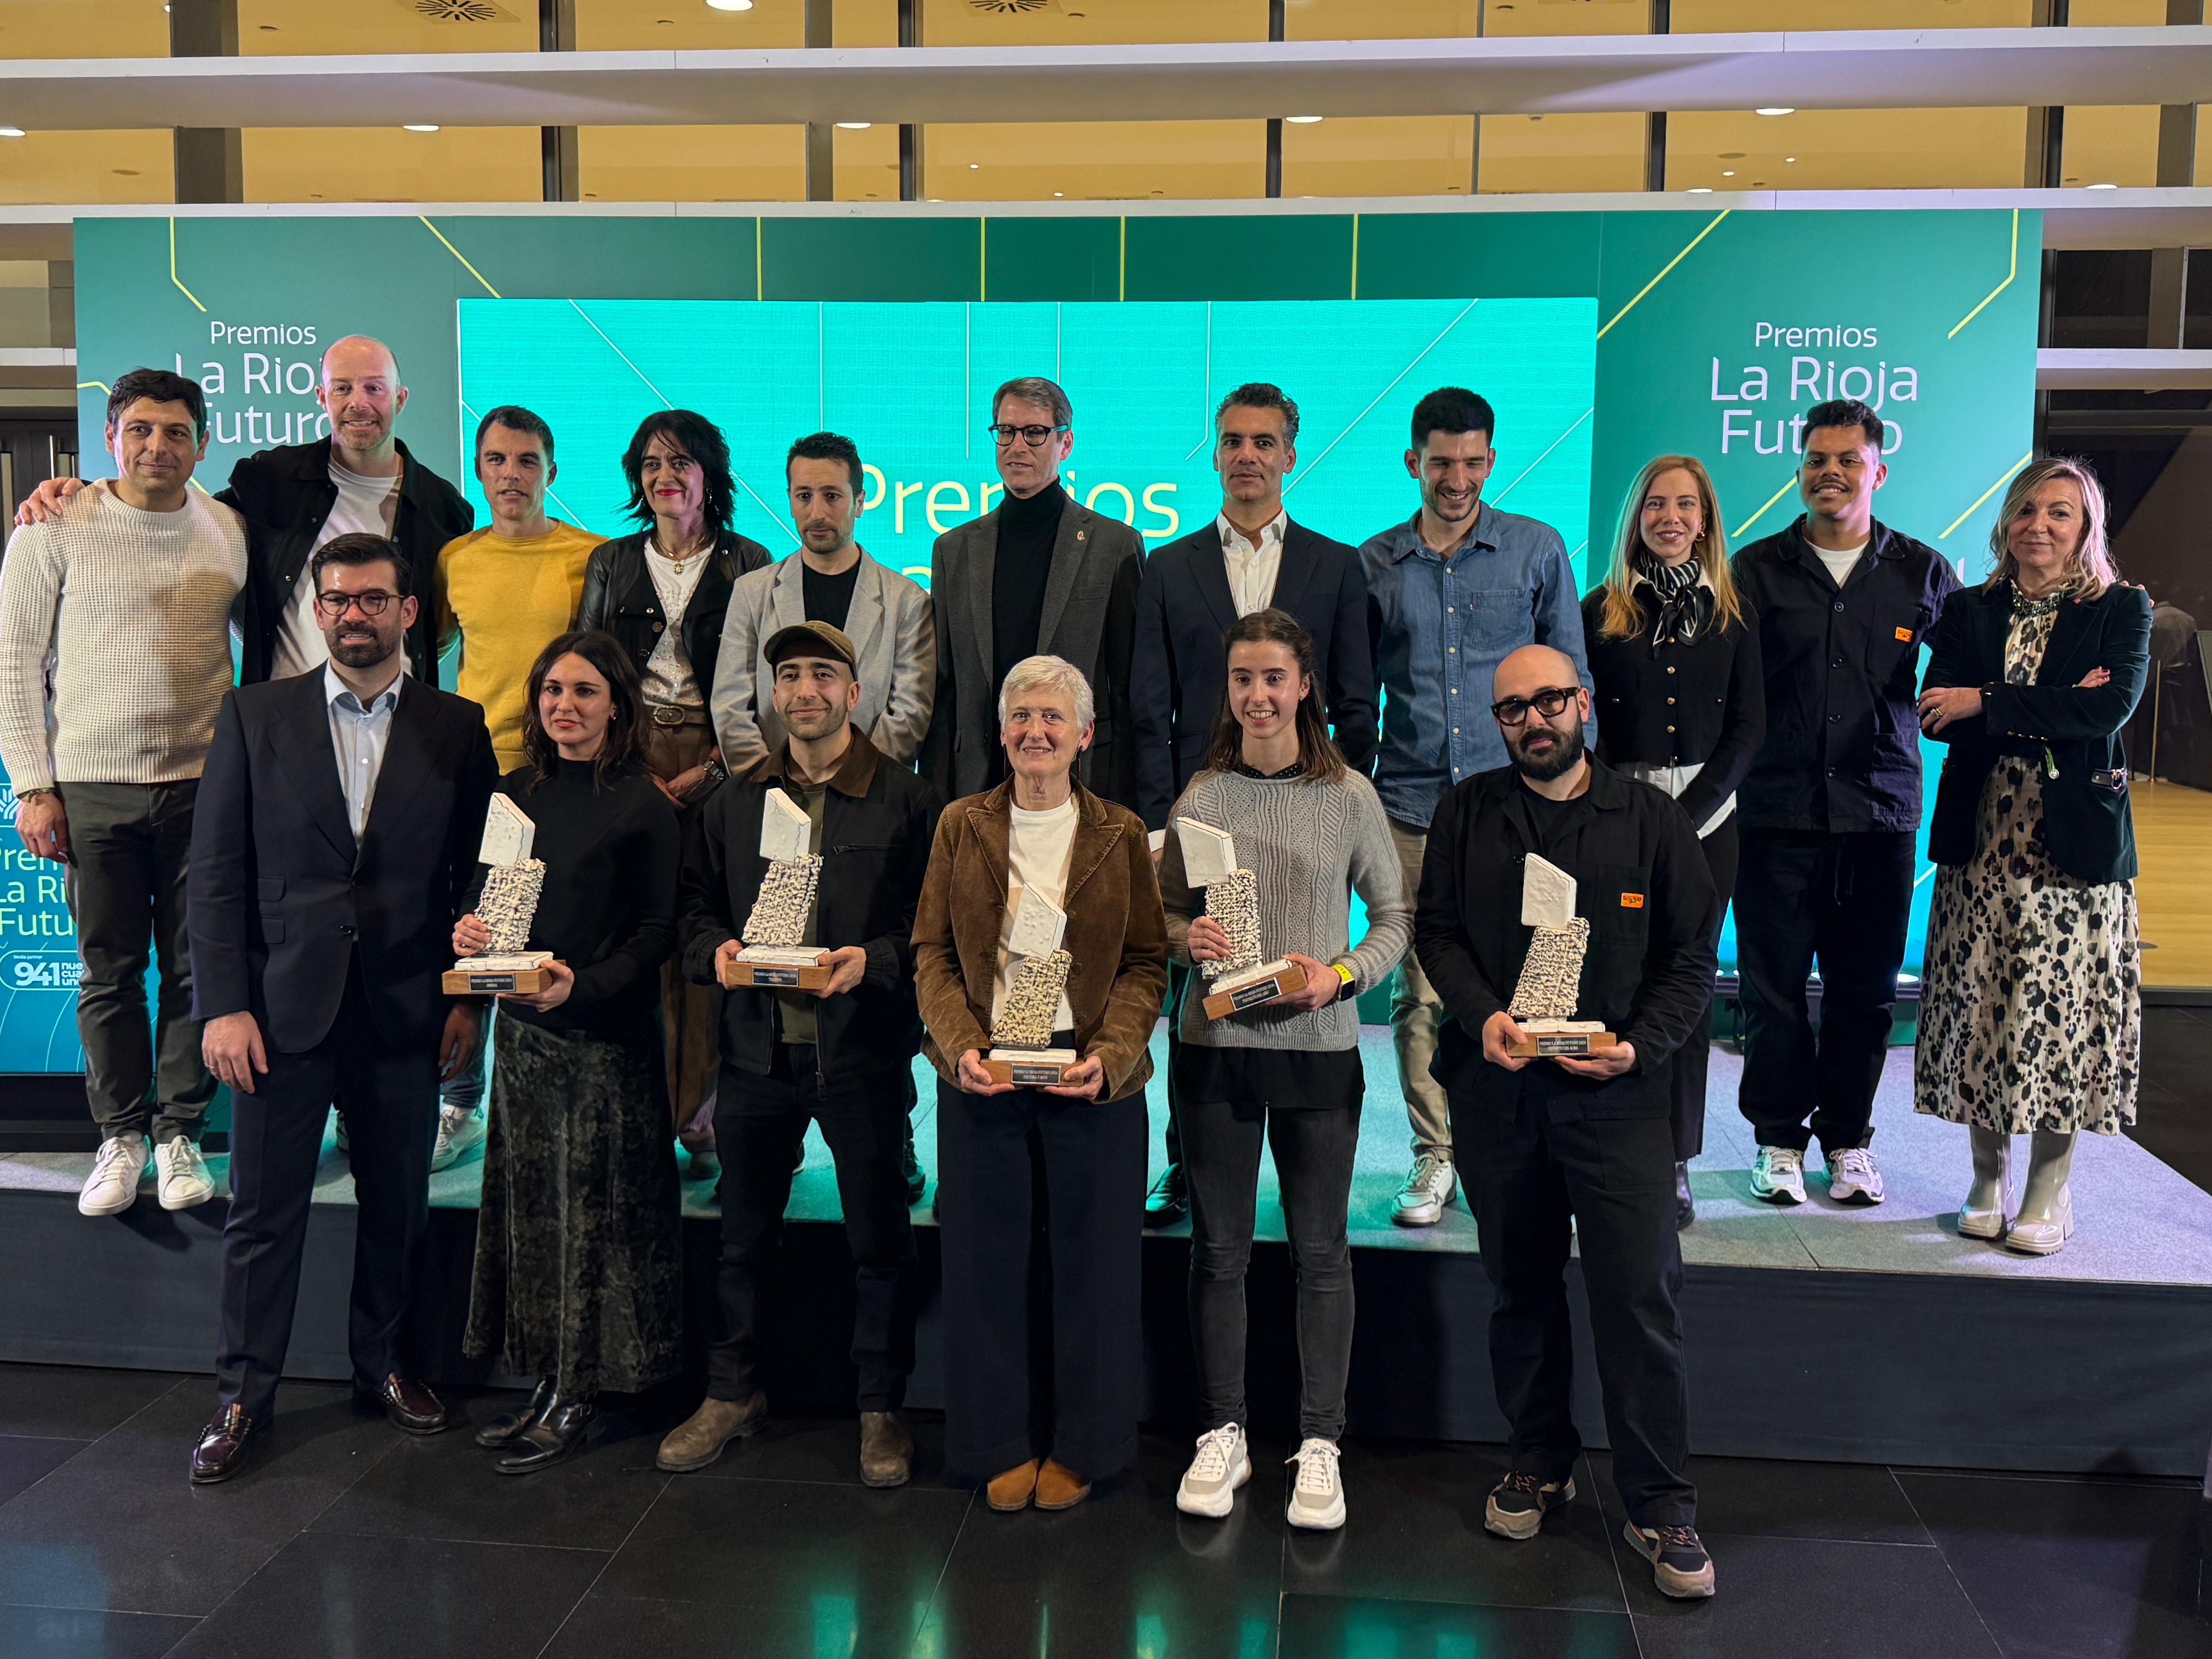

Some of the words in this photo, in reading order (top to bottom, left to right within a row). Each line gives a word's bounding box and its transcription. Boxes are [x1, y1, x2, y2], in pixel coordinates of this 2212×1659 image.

[211, 321, 316, 345] Premios
[1756, 322, 1877, 347] Premios
[244, 353, 322, 405] Rio
[1711, 356, 1768, 401] La
[1791, 356, 1918, 412] Rioja
[1721, 409, 1903, 455] Futo
[0, 908, 73, 936] Futu
[14, 962, 60, 986] 941
